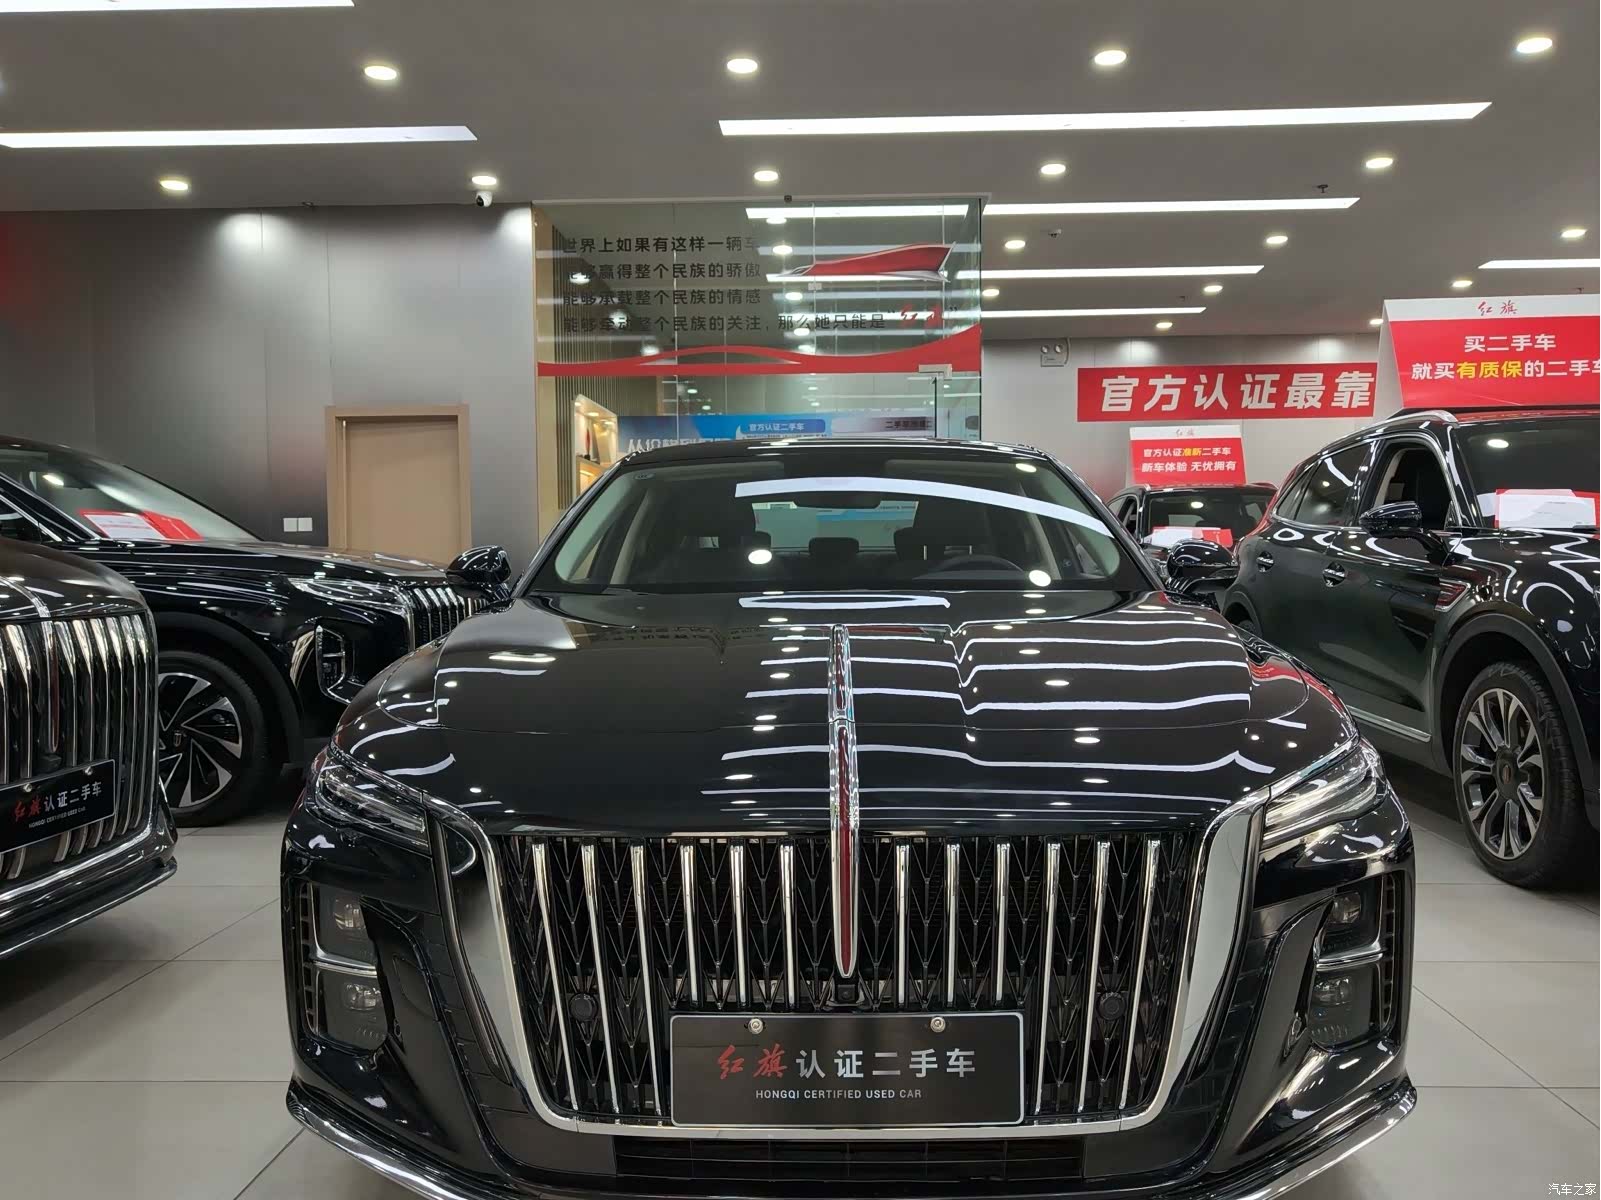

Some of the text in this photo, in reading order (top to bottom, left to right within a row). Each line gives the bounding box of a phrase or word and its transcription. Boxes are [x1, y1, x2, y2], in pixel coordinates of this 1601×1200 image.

[1478, 300, 1518, 316] 红旗
[1464, 334, 1556, 352] 买二手车
[1101, 371, 1375, 412] 官方认证最靠
[1143, 447, 1232, 458] 官方认证准新二手车
[1141, 461, 1237, 473] 新车体验 无忧拥有
[14, 781, 102, 822] 红旗认证二手车
[718, 1043, 976, 1079] 红旗认证二手车
[755, 1089, 922, 1099] HONGQI CERTIFIED USED CAR
